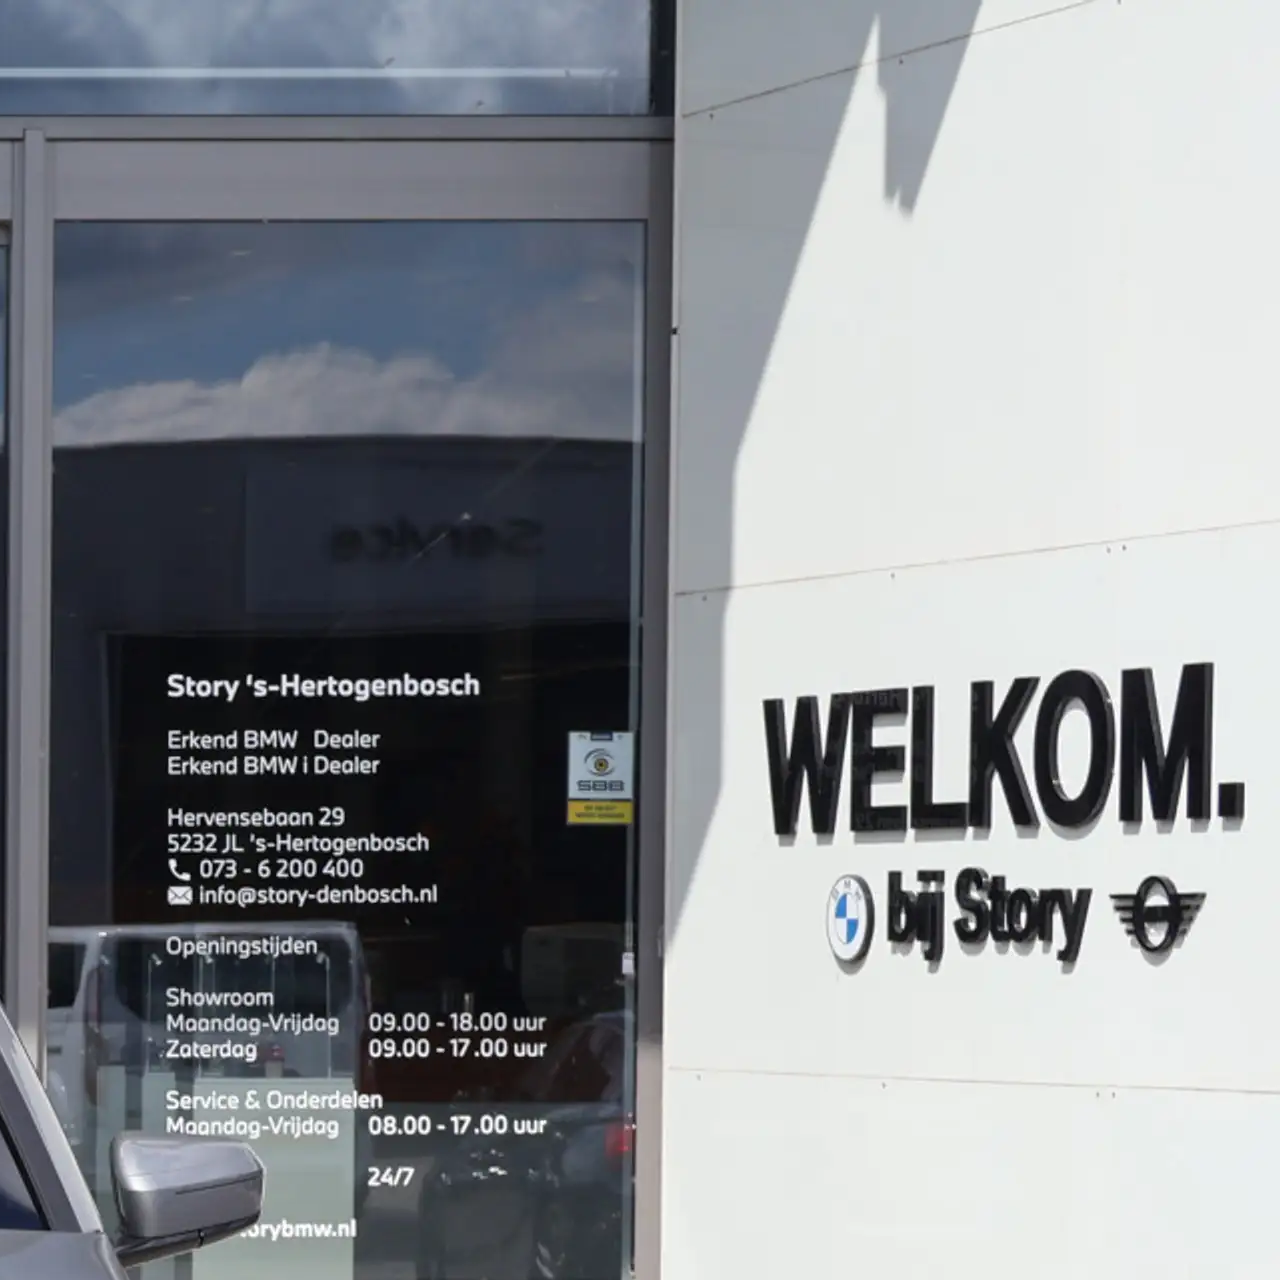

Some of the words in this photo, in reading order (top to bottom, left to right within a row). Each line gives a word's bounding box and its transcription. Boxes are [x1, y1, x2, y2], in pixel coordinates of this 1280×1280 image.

[167, 673, 240, 702] Story
[168, 730, 238, 749] Erkend
[244, 730, 298, 749] BMW
[314, 729, 381, 749] Dealer
[762, 662, 1245, 836] WELKOM.
[167, 755, 238, 775] Erkend
[243, 755, 298, 775] BMW
[303, 755, 308, 774] i
[314, 755, 380, 775] Dealer
[167, 807, 314, 827] Hervensebaan
[319, 806, 345, 826] 29
[167, 833, 217, 853] 5232
[221, 833, 245, 854] JL
[199, 859, 237, 879] 073
[258, 859, 271, 878] 6
[276, 859, 317, 878] 200
[322, 858, 364, 878] 400
[199, 884, 438, 908] info@story-denbosch.nl
[887, 870, 946, 962] bij
[953, 867, 1093, 963] Story
[166, 935, 318, 961] Openingstijden
[166, 987, 274, 1007] Showroom
[166, 1013, 340, 1037] Maandag-Vrijdag
[369, 1012, 430, 1032] 09.00
[449, 1012, 508, 1032] 18.00
[513, 1017, 547, 1032] uur
[166, 1039, 257, 1062] Zaterdag
[369, 1038, 430, 1058] 09.00
[513, 1043, 547, 1058] uur
[166, 1090, 240, 1110] Service
[244, 1089, 261, 1110] &
[266, 1090, 382, 1110] Onderdelen
[166, 1116, 339, 1140] Maandag-Vrijdag
[368, 1115, 431, 1135] 08.00
[513, 1119, 548, 1135] uur
[367, 1167, 415, 1187] 24/7
